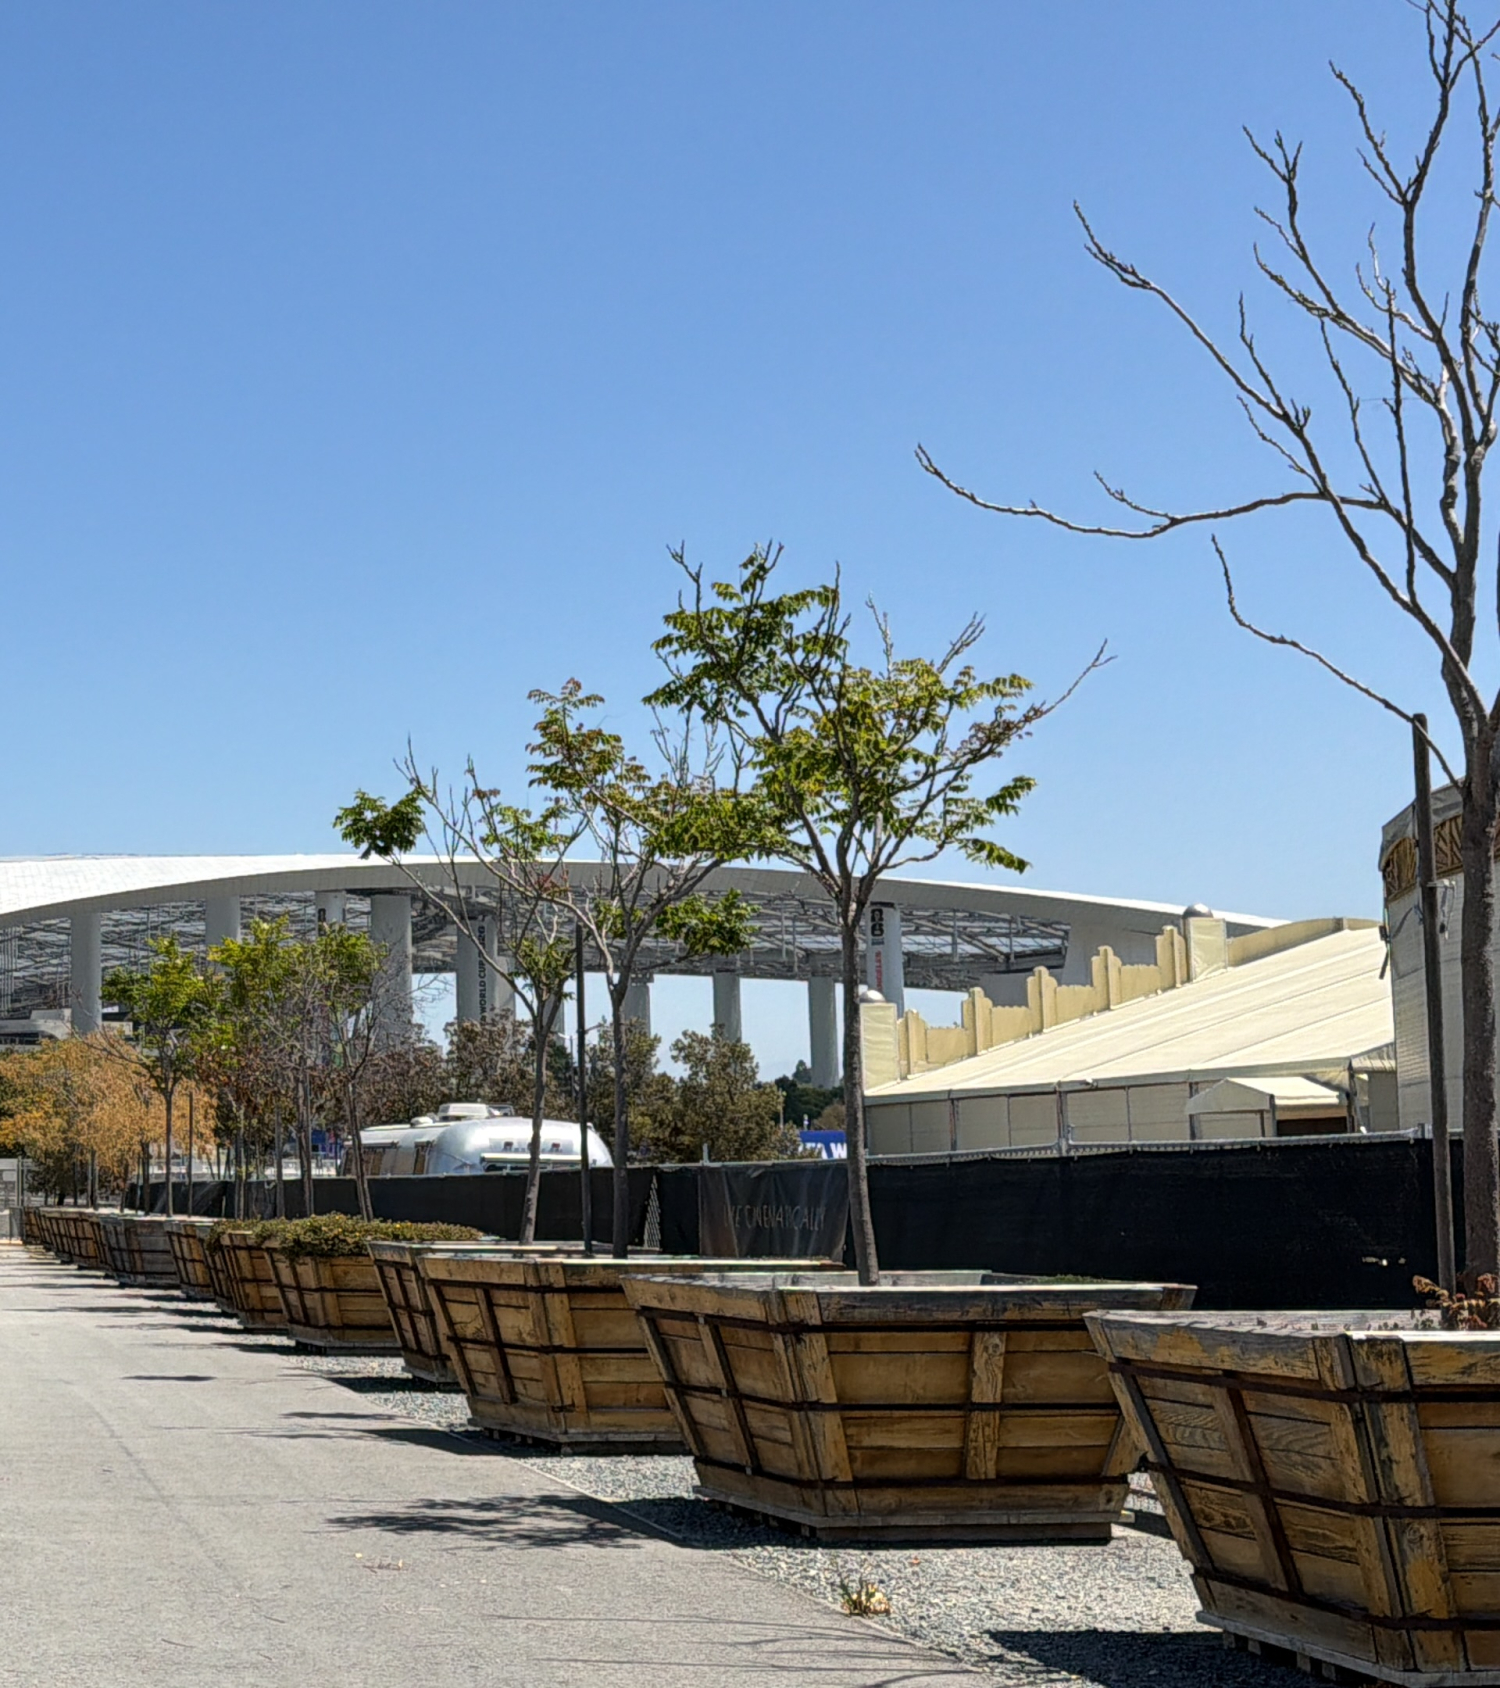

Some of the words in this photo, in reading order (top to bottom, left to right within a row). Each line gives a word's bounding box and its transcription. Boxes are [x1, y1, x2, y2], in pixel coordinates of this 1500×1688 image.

[478, 960, 486, 979] CUP
[479, 980, 487, 1014] WORLD
[724, 1204, 742, 1228] LVE
